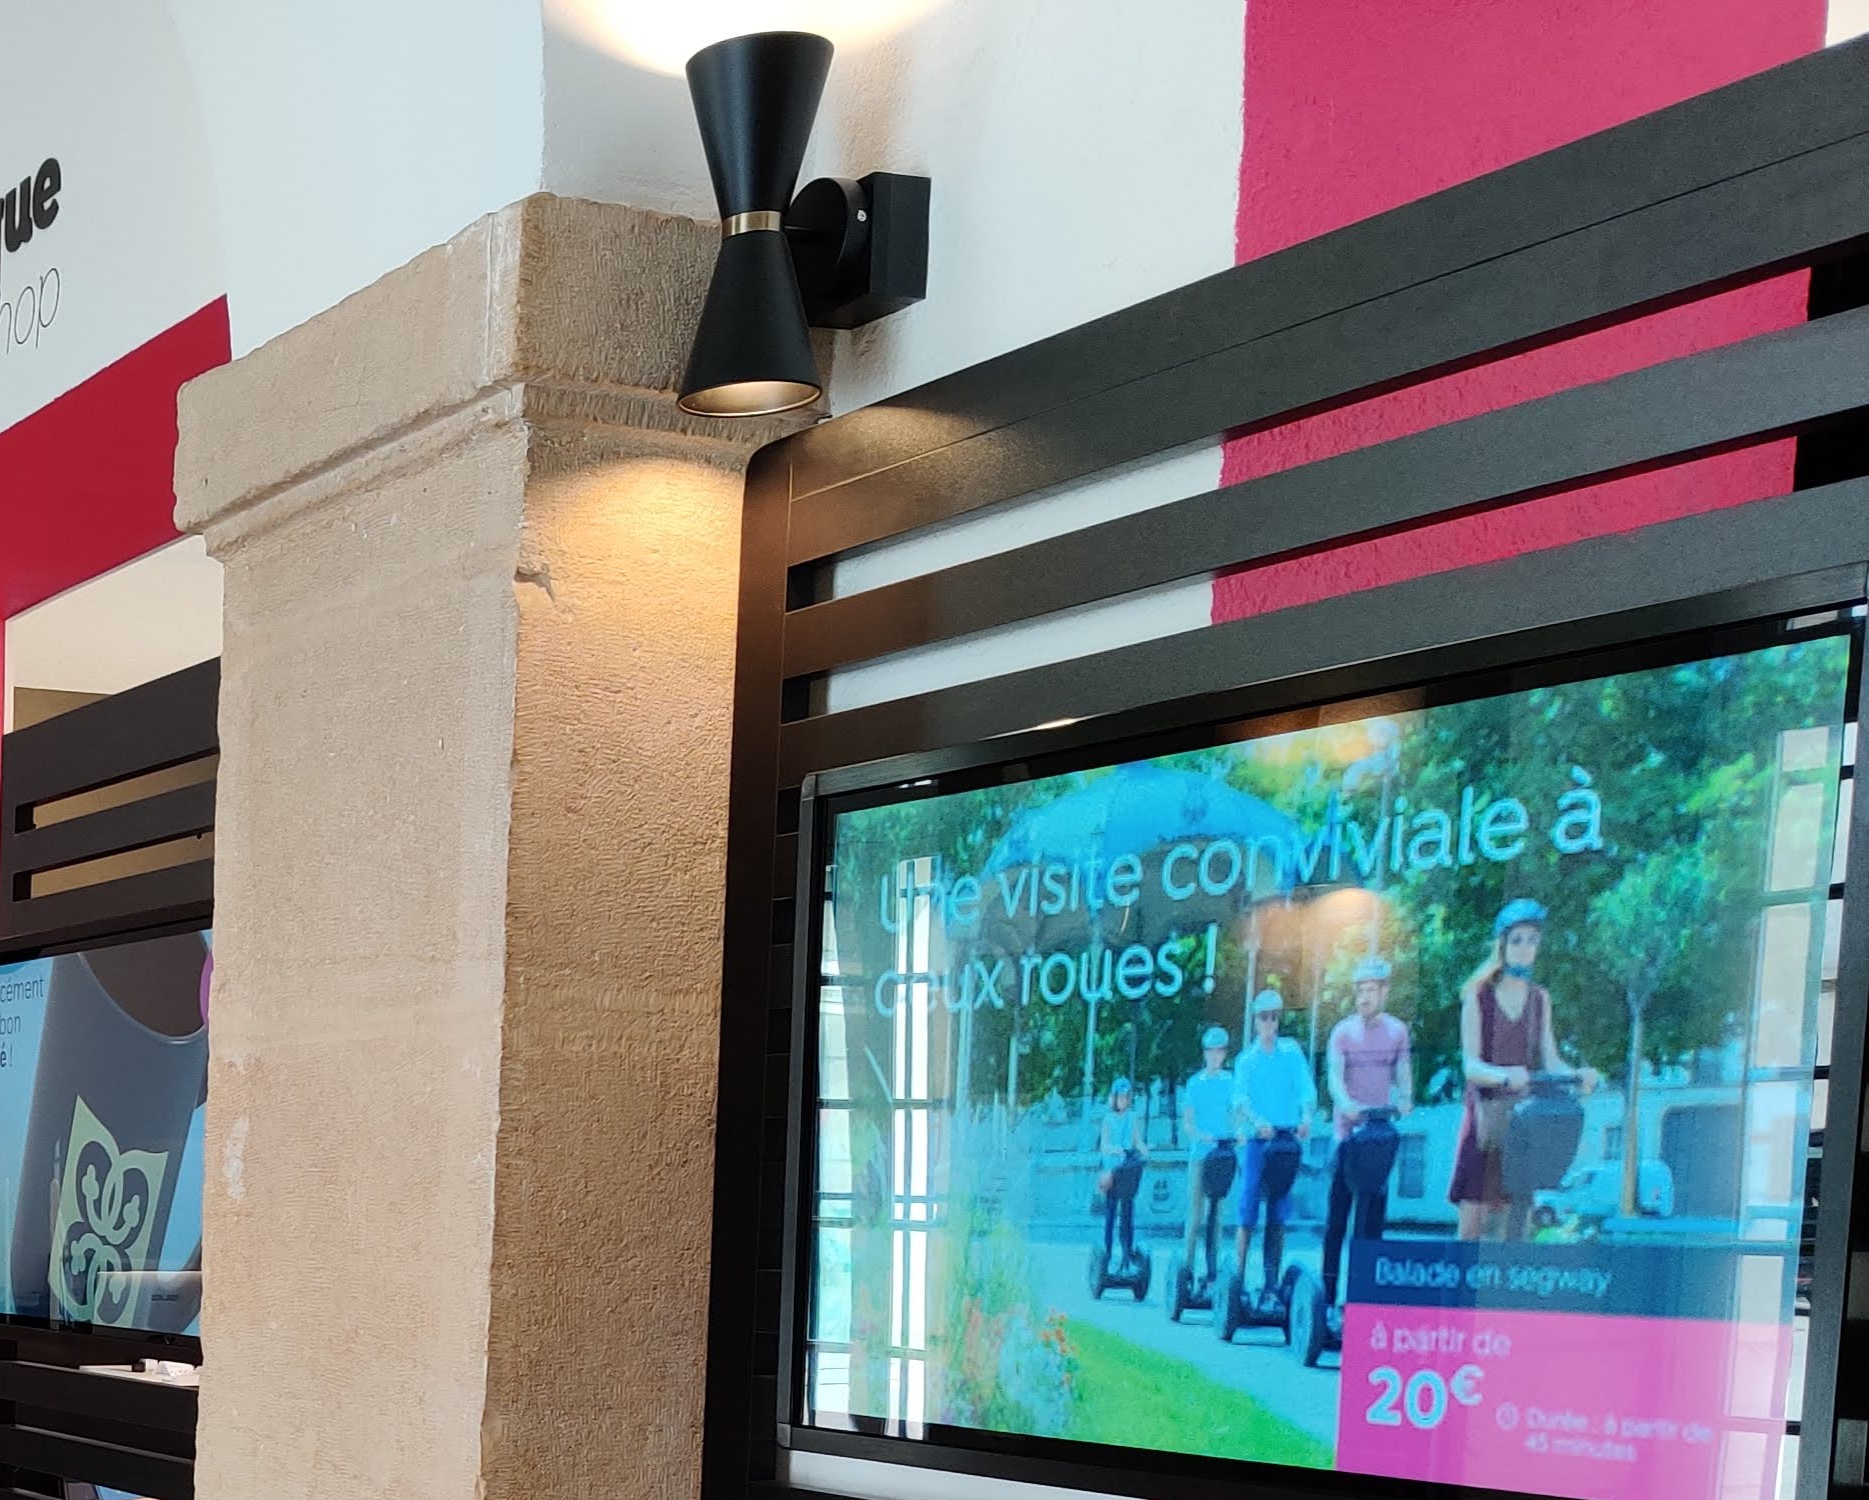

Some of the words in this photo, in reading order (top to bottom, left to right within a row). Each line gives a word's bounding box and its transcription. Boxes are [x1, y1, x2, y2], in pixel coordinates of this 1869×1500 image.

[997, 846, 1143, 919] visite
[1161, 782, 1528, 901] conviviale
[1552, 764, 1605, 855] à
[1020, 942, 1184, 1006] roues
[0, 1011, 22, 1035] bon
[1375, 1256, 1460, 1289] Balade
[1465, 1263, 1502, 1289] en
[1508, 1265, 1612, 1297] segway
[1392, 1324, 1466, 1353] partir
[1472, 1330, 1512, 1357] de
[1365, 1363, 1485, 1430] 20€
